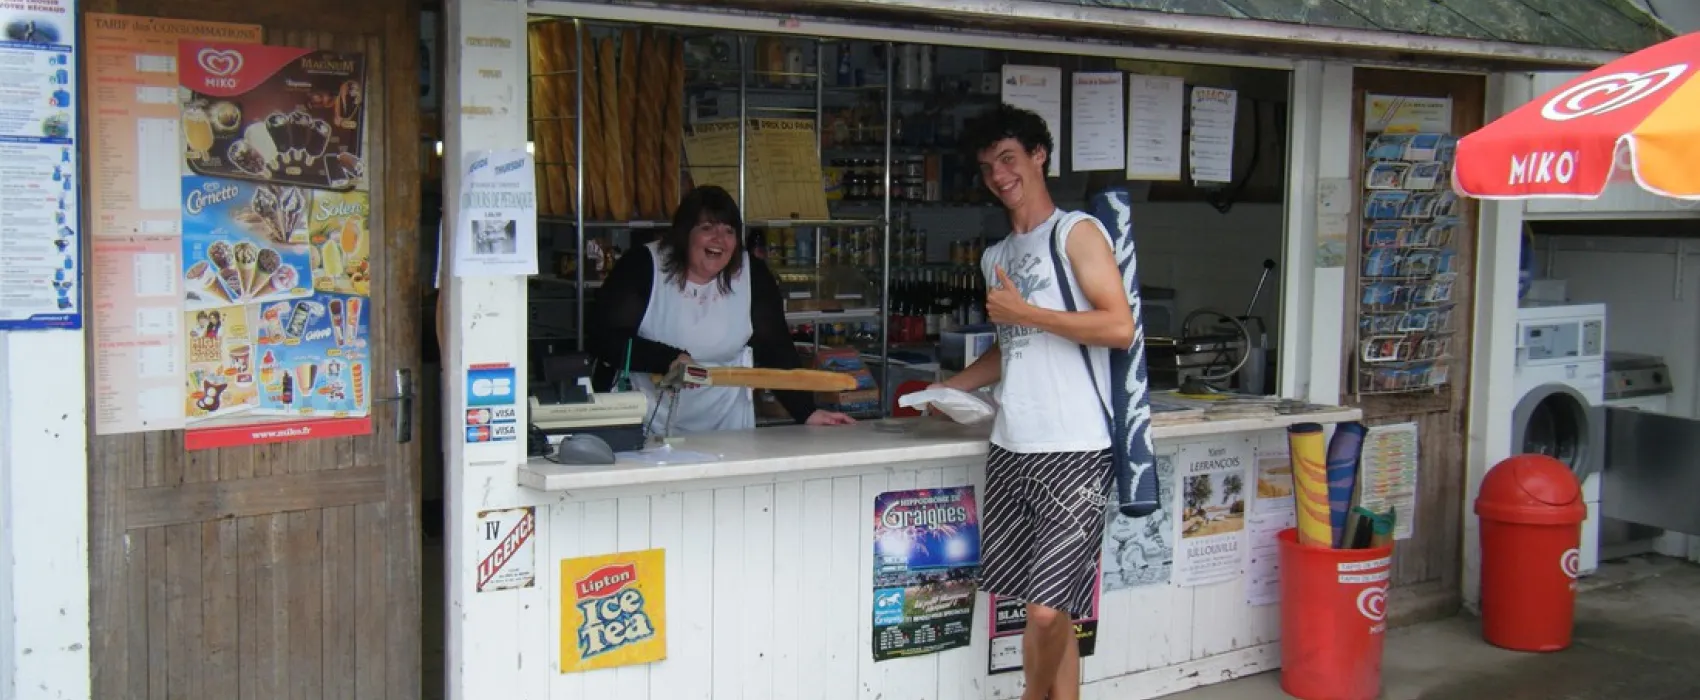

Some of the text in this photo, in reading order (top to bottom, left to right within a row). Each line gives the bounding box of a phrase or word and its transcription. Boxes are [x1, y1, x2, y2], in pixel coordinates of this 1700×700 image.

[94, 18, 127, 30] TARIF
[153, 24, 255, 40] CONSOMMATIONS
[205, 77, 236, 88] MIKO
[761, 120, 813, 130] PRIX DU PAIN
[1508, 151, 1574, 185] MIKO
[187, 184, 239, 215] Cornetto
[495, 409, 516, 418] VISA
[495, 426, 516, 435] VISA
[1189, 457, 1241, 473] LEFRANÇOIS
[882, 499, 968, 530] Graignes
[486, 520, 501, 541] IV
[478, 511, 534, 587] LICENCE
[581, 571, 630, 595] Lipton
[580, 589, 642, 625] Ice
[580, 612, 653, 655] Tea
